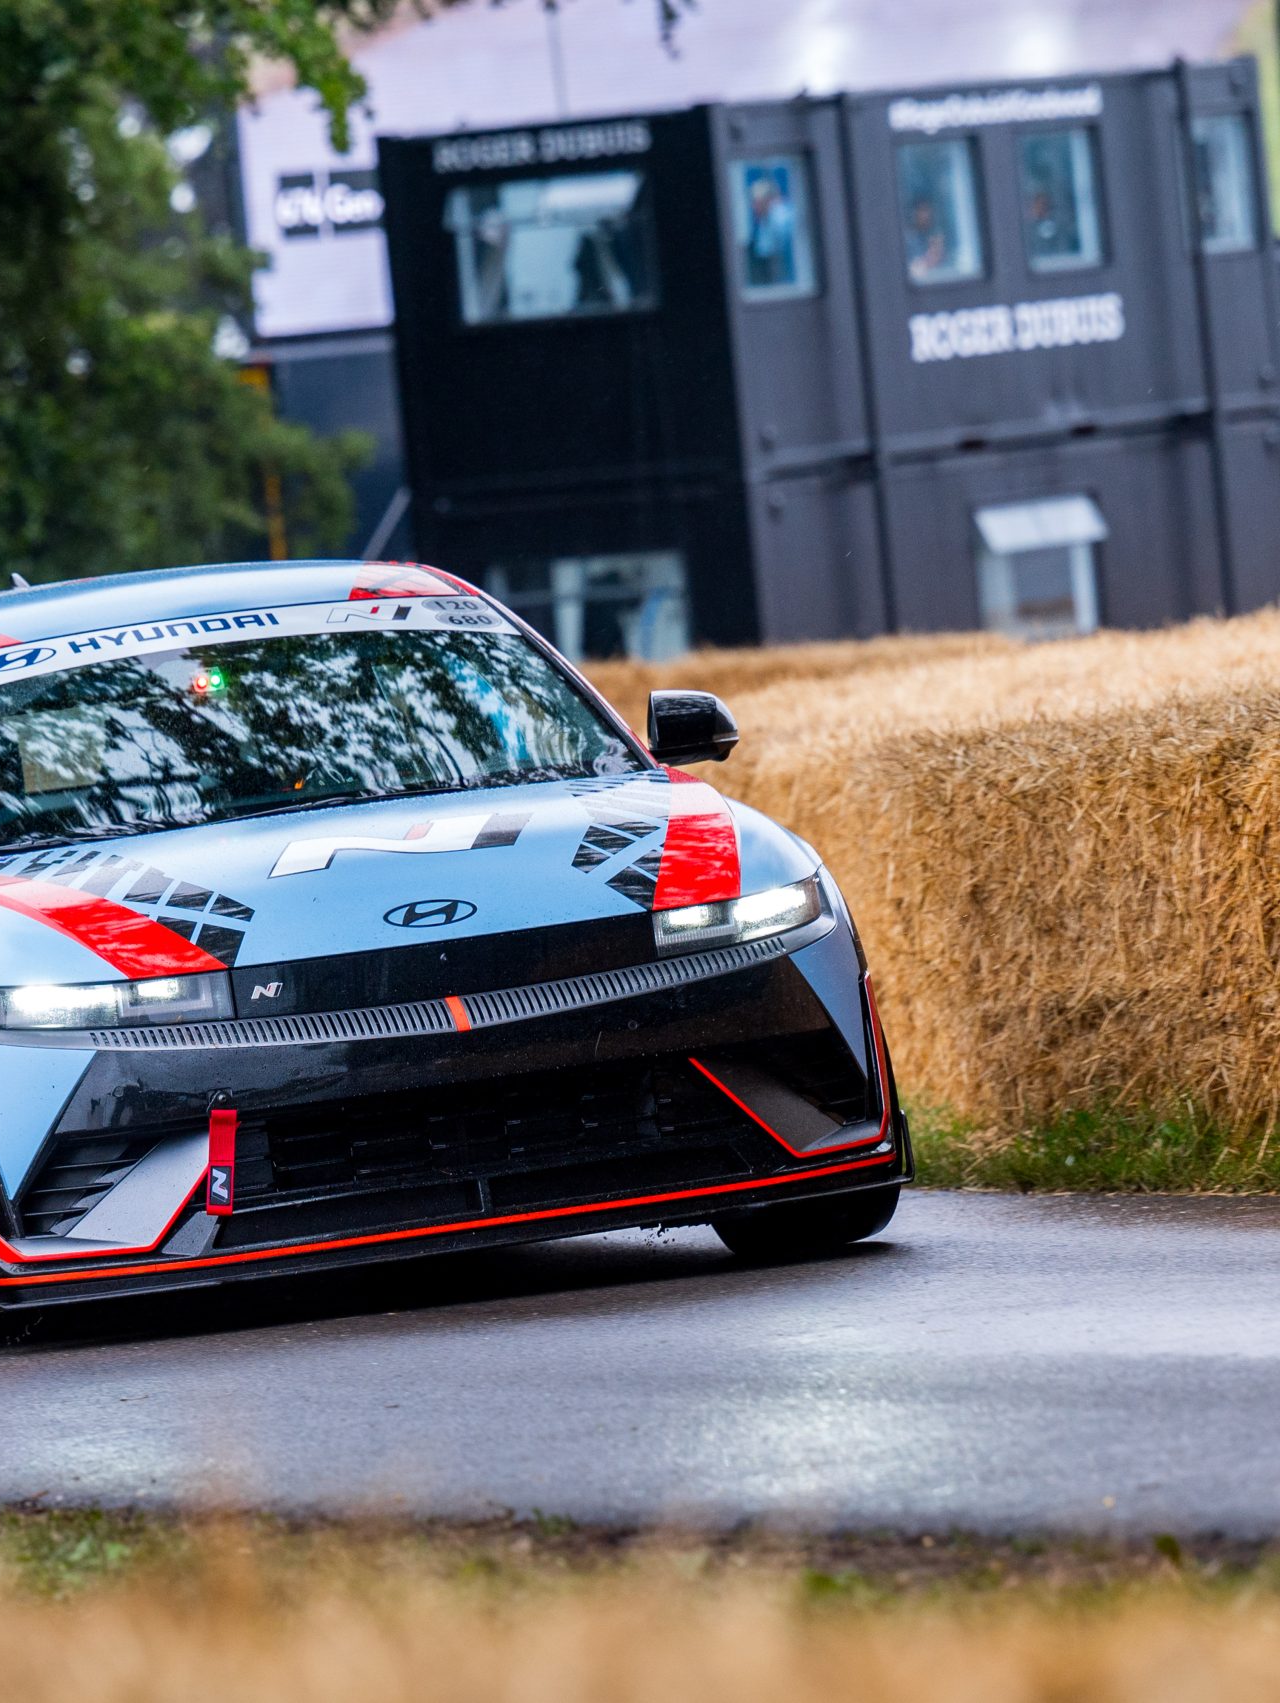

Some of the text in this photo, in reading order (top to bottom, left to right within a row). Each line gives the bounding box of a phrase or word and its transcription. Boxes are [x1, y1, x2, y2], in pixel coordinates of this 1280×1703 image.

[434, 132, 535, 172] ROGER
[909, 292, 1124, 362] ROGER DUBUIS
[435, 600, 478, 611] 120
[448, 614, 493, 626] 680
[68, 612, 280, 654] HYUNDAI
